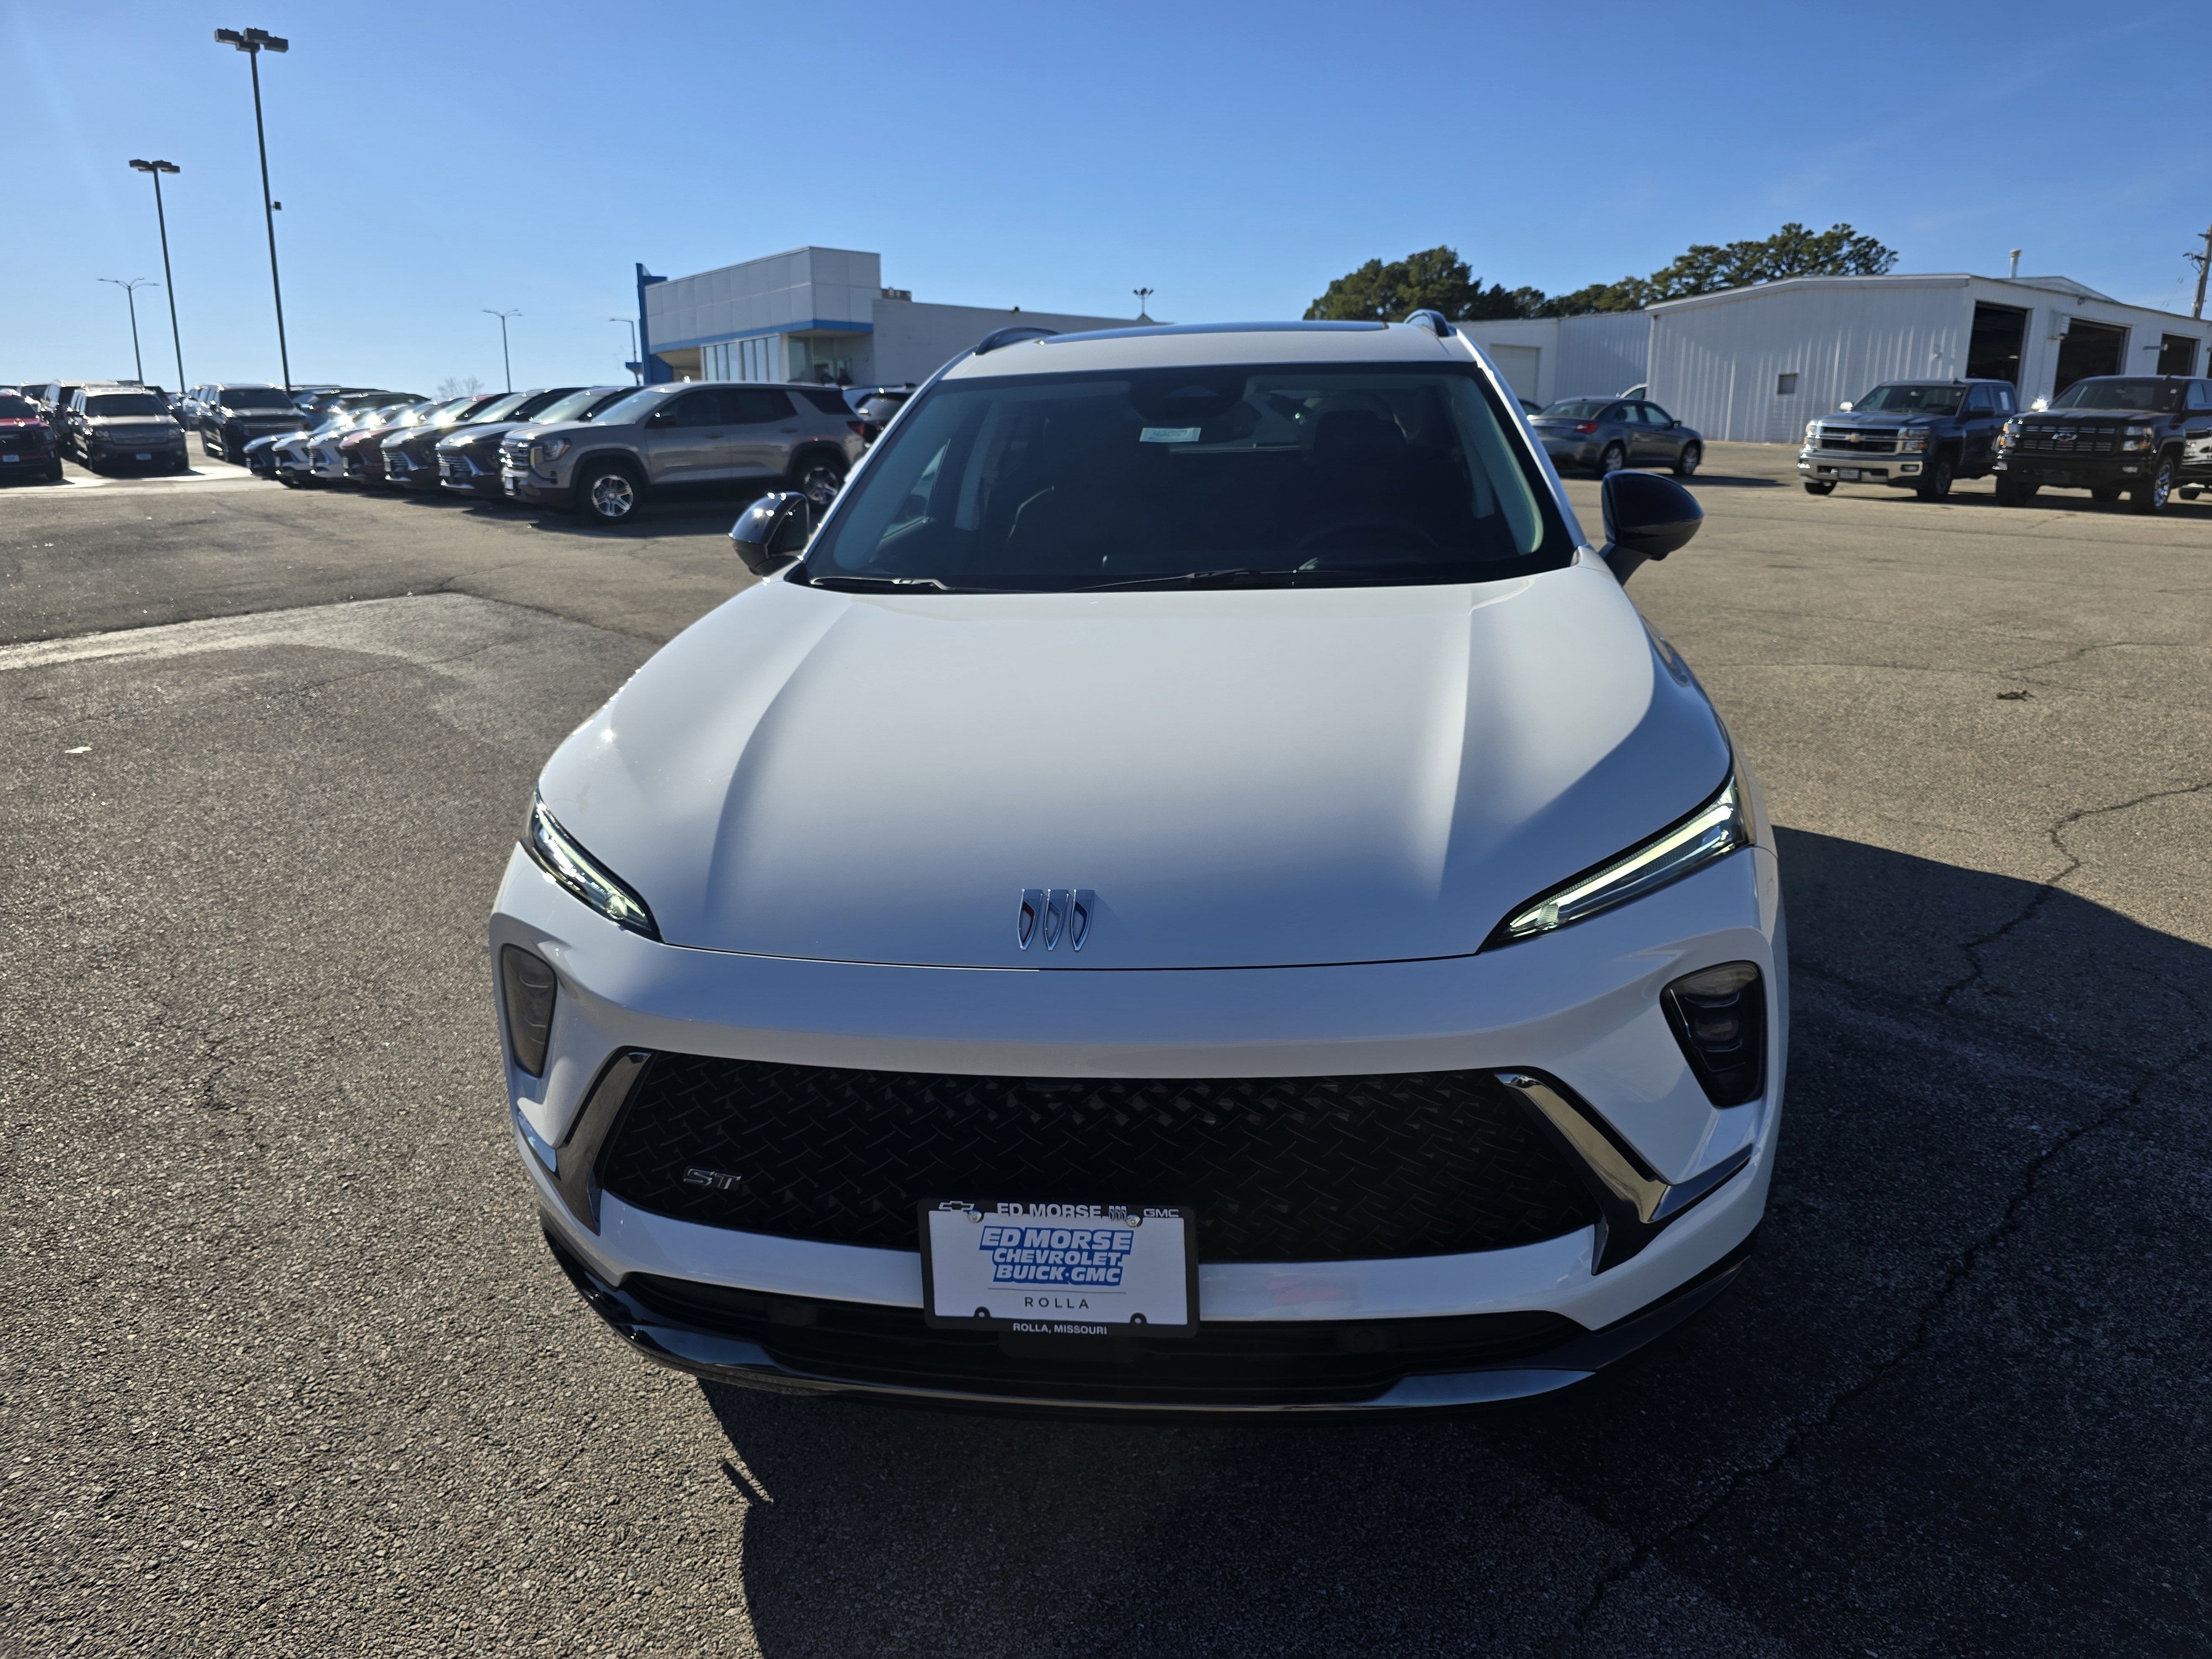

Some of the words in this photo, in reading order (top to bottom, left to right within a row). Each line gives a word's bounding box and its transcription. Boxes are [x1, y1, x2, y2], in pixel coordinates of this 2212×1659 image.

[684, 1168, 742, 1190] ST
[997, 1203, 1023, 1217] ED
[1029, 1203, 1101, 1218] MORSE
[1143, 1208, 1180, 1218] GMC
[981, 1228, 1021, 1246] ED
[1023, 1229, 1132, 1250] MORSE
[994, 1248, 1121, 1266] CHEVROLET
[1025, 1297, 1089, 1310] ROLLA
[1013, 1322, 1051, 1334] ROLLA,
[1054, 1324, 1107, 1335] MISSOURI
